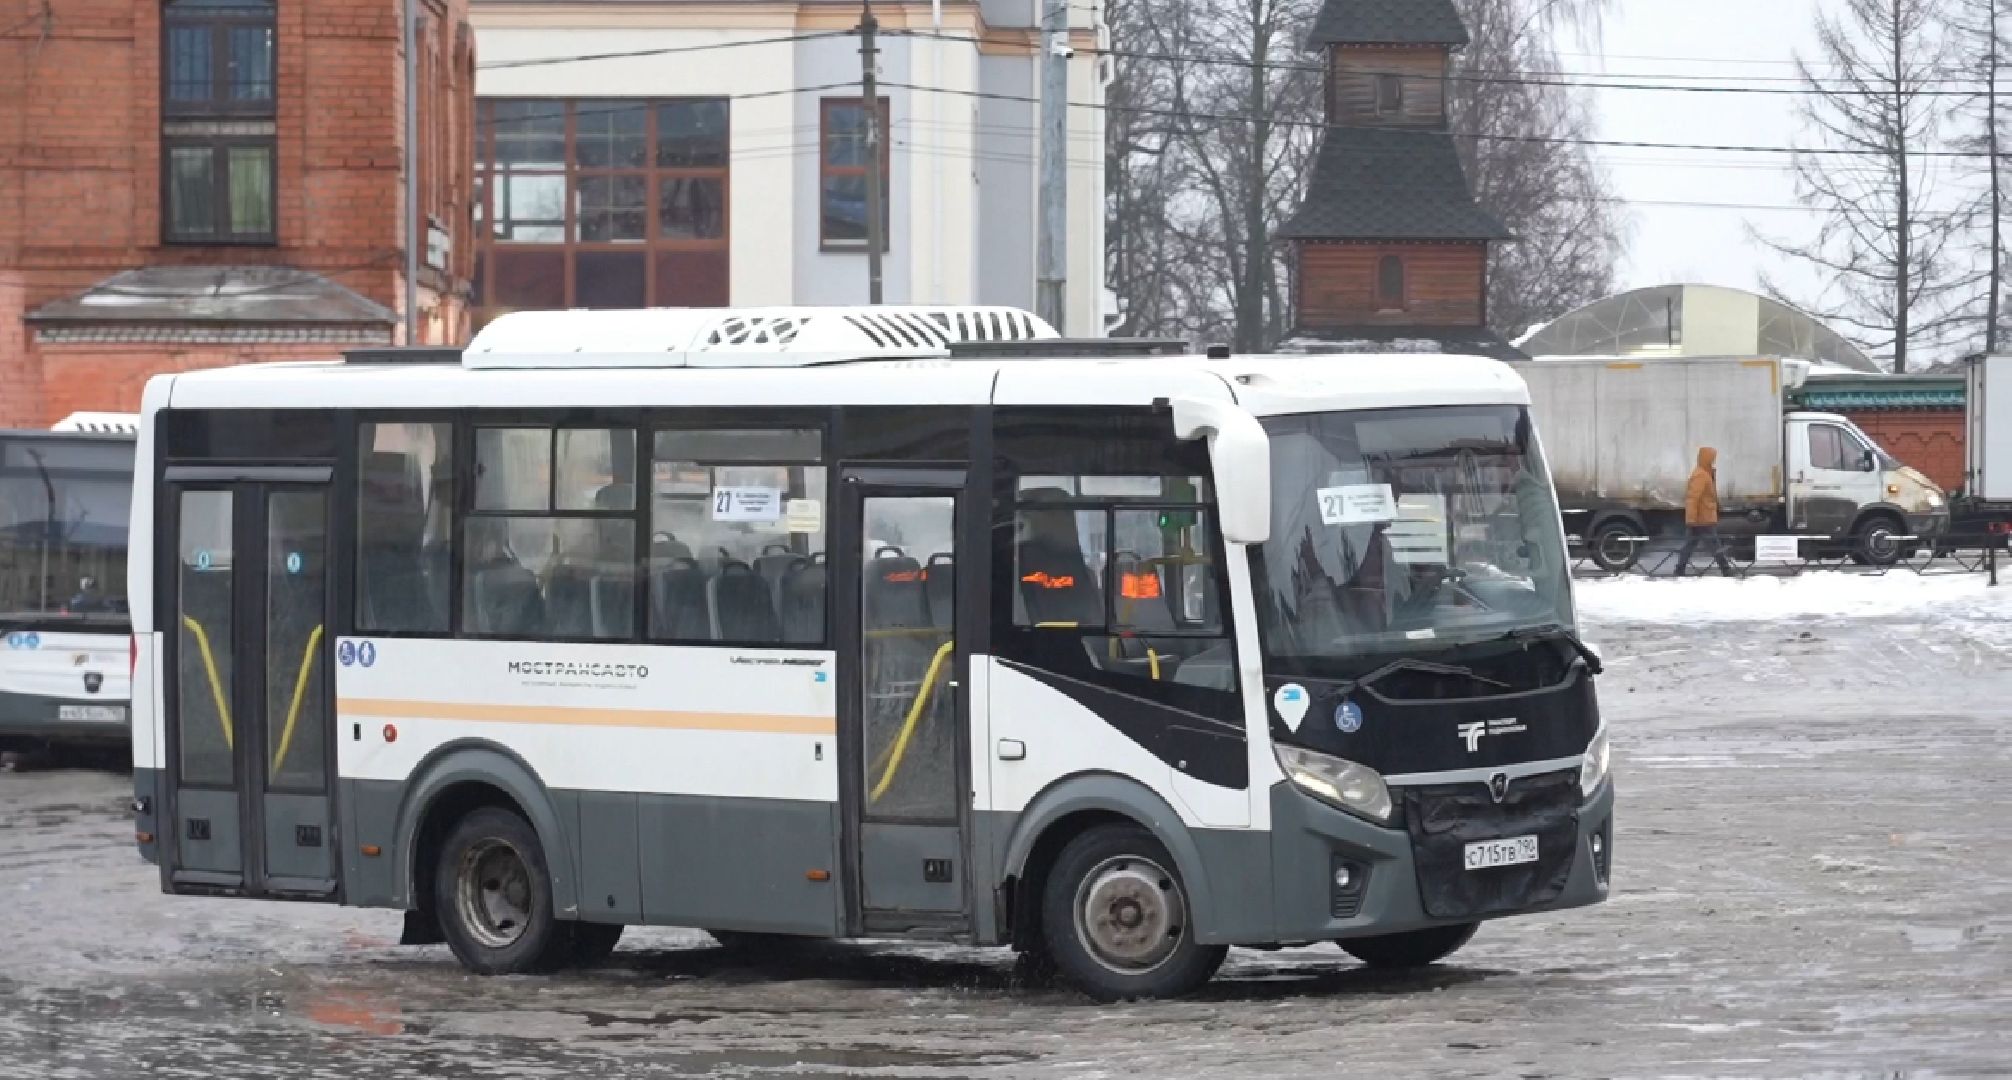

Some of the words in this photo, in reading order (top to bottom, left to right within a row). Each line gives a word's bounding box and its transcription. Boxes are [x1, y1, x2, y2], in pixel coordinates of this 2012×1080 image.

[716, 491, 731, 513] 27
[1324, 494, 1344, 517] 27
[508, 661, 649, 678] МОСТРАНСАВТО
